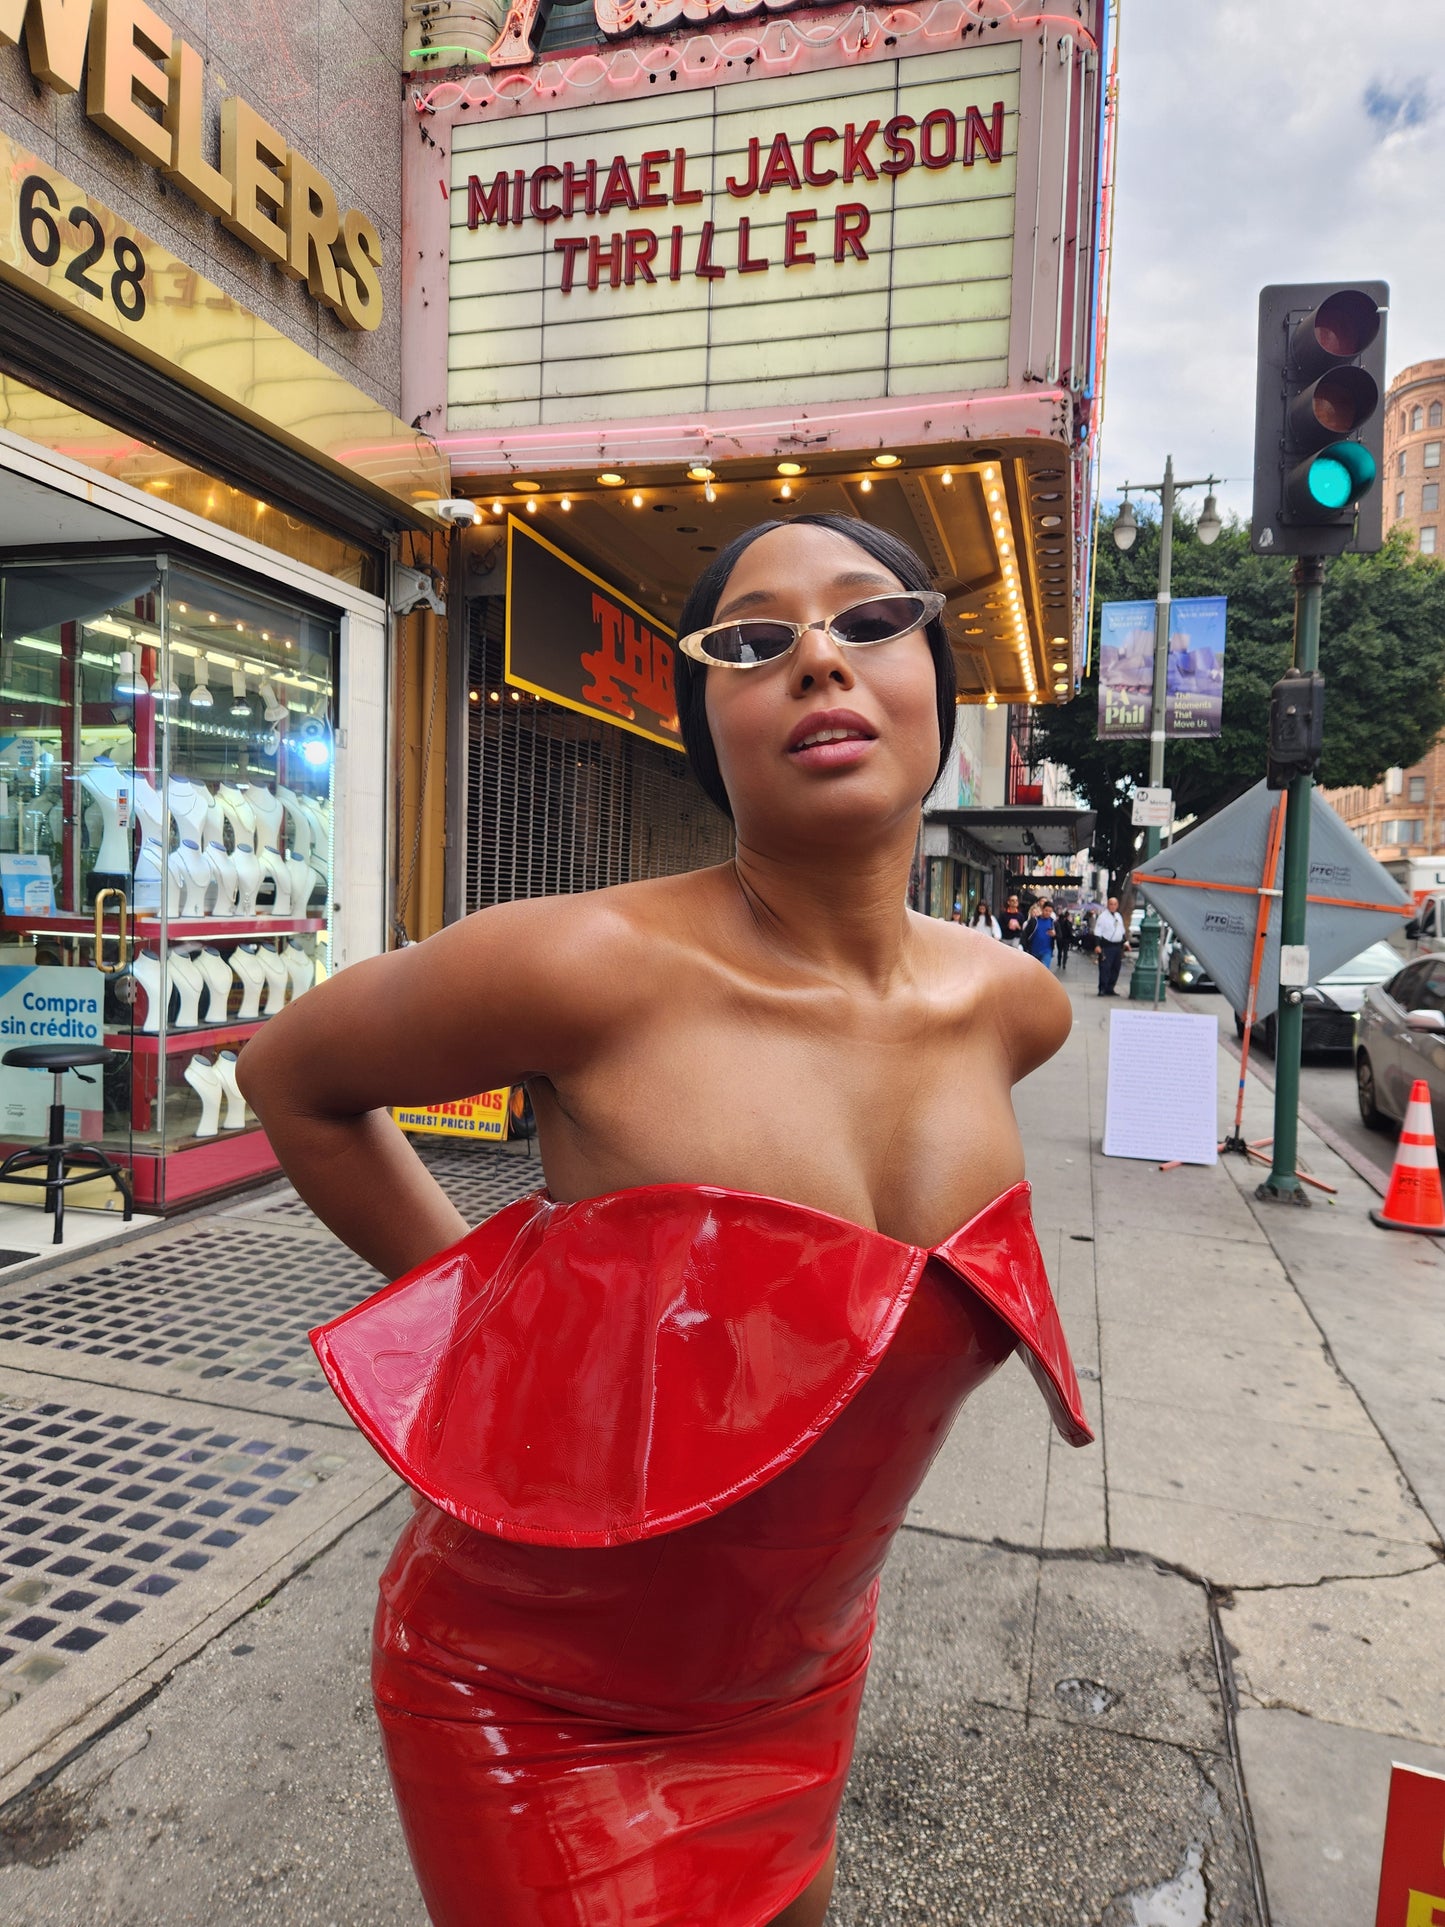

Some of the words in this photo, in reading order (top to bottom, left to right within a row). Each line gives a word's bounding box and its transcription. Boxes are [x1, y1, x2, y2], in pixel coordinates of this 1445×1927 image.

[466, 147, 703, 229] MICHAEL
[726, 101, 1004, 197] JACKSON
[19, 175, 146, 322] 628
[553, 203, 871, 292] THRILLER
[1105, 688, 1130, 706] LA
[1174, 699, 1212, 709] Moments
[1105, 704, 1145, 725] Phil
[1173, 720, 1195, 728] Move
[1197, 719, 1208, 728] Us
[1174, 710, 1193, 719] That
[1310, 866, 1333, 876] PTC
[1206, 915, 1229, 925] PTC
[22, 992, 97, 1017] Compra
[1, 1016, 25, 1035] sin
[30, 1018, 97, 1038] crédito
[426, 1103, 473, 1117] ORO
[399, 1112, 437, 1127] HIGHEST
[440, 1117, 475, 1130] PRICES
[478, 1121, 502, 1133] PAID
